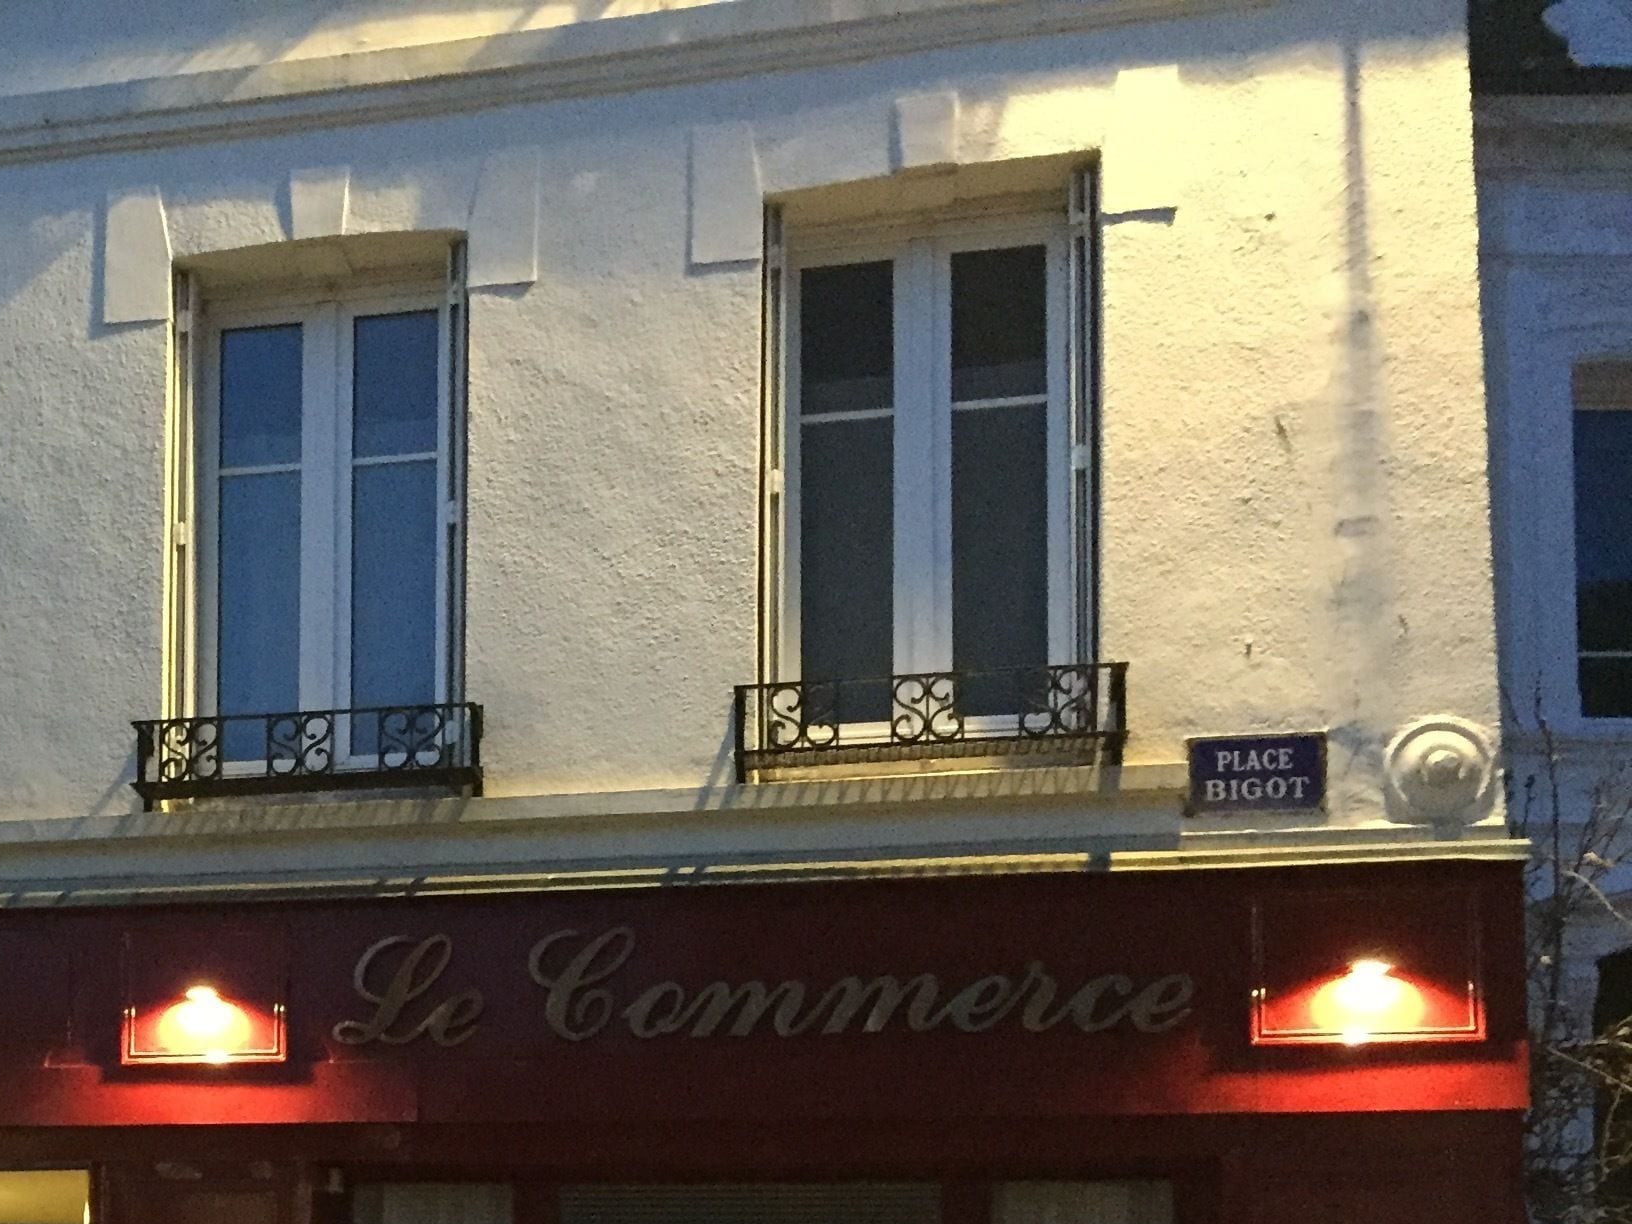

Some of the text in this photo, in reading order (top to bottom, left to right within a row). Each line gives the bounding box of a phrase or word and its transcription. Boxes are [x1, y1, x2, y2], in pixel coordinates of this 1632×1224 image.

[1216, 748, 1294, 772] PLACE
[1204, 776, 1310, 801] BIGOT
[331, 926, 1197, 1047] Le Commerce
